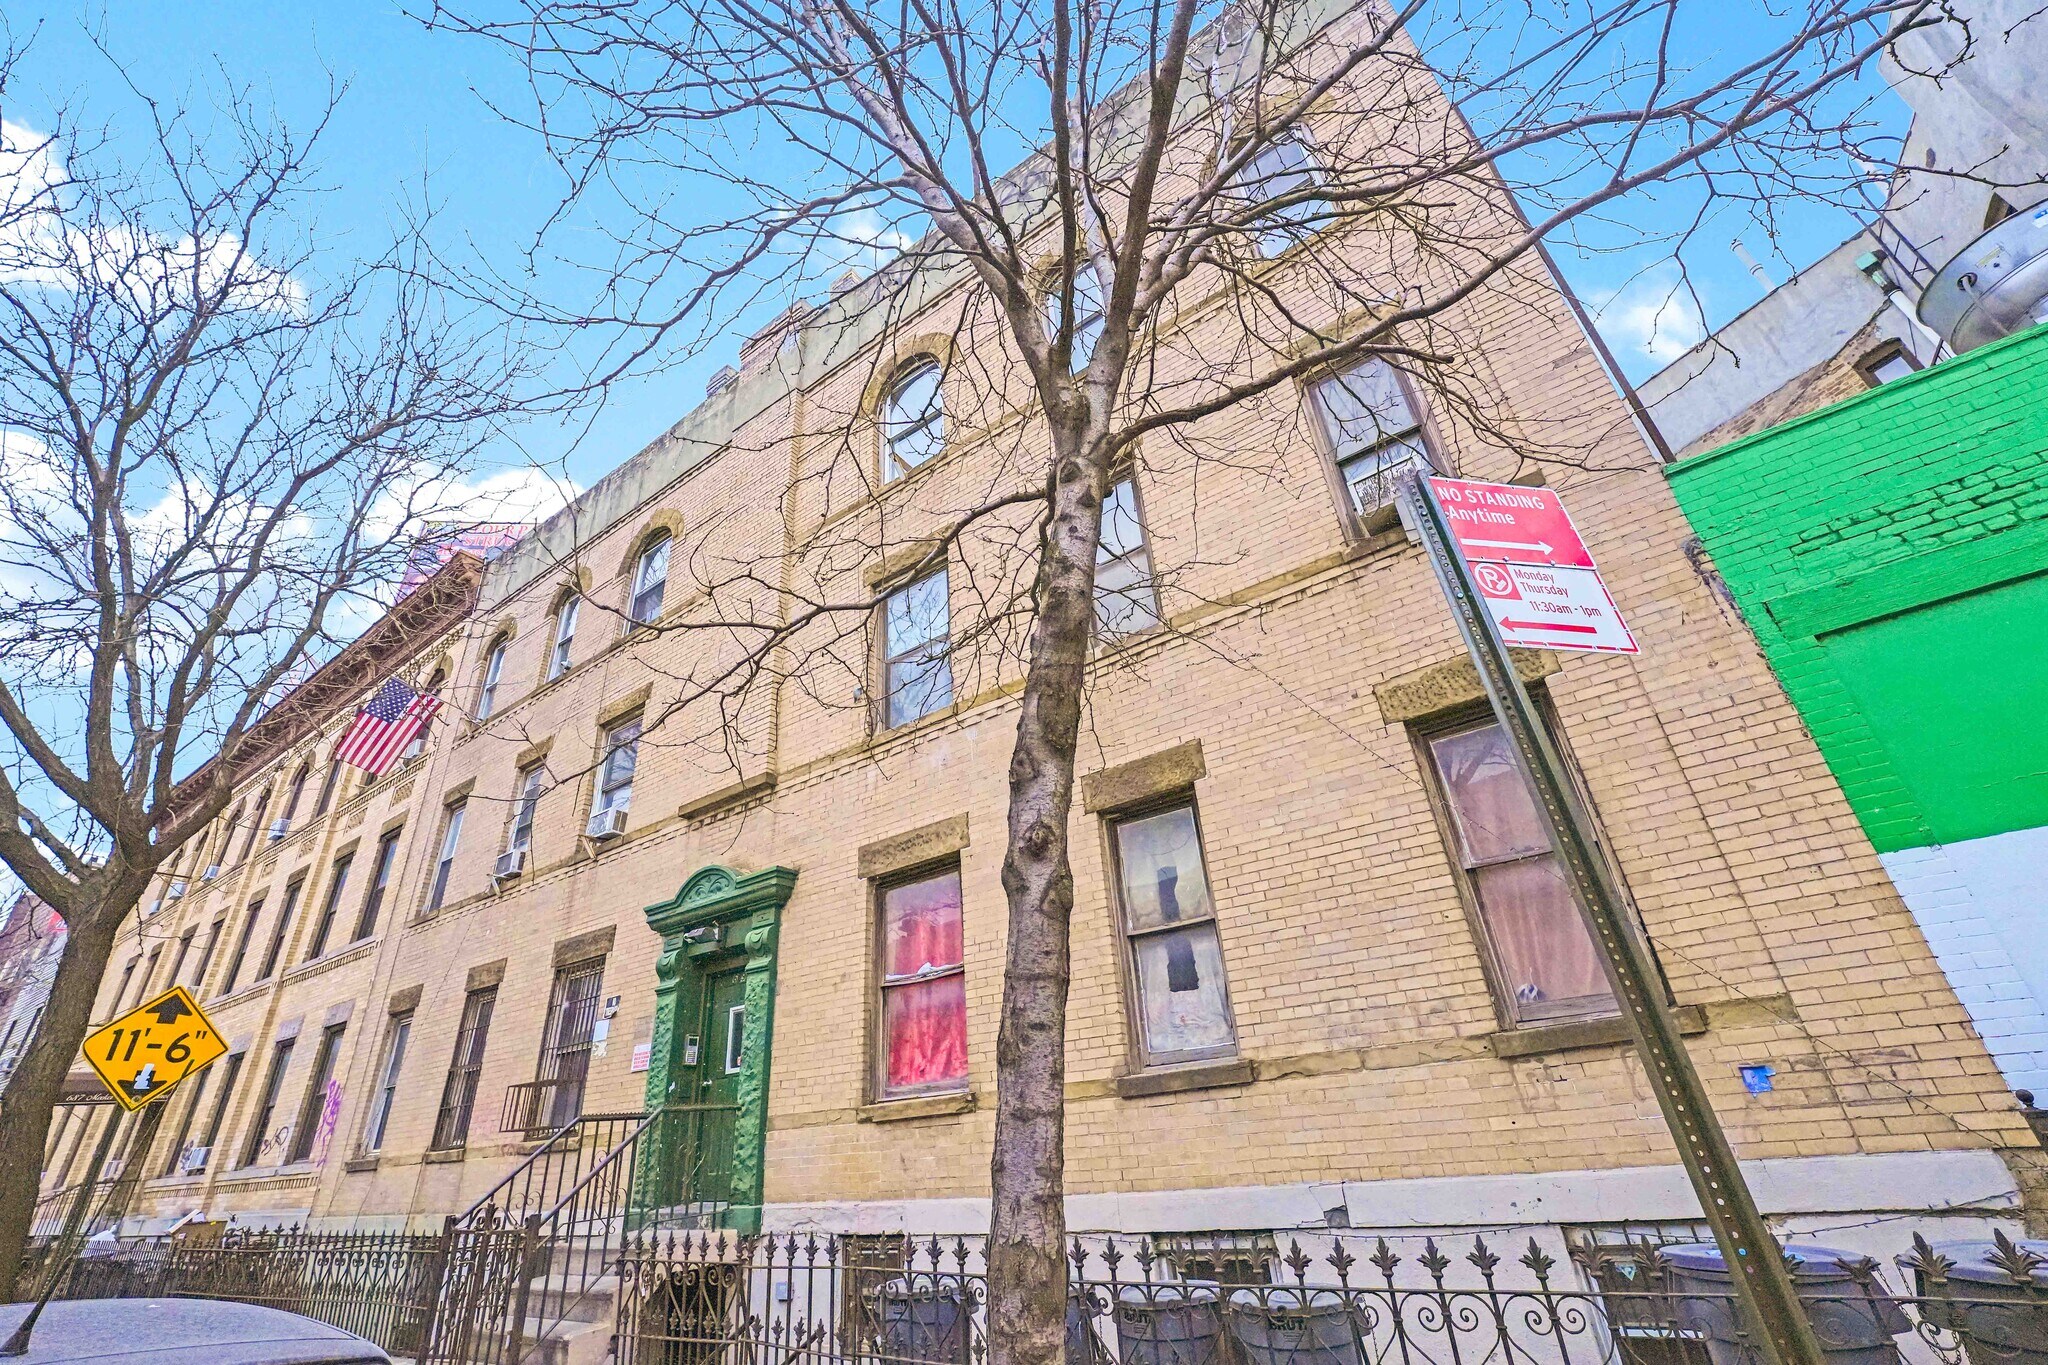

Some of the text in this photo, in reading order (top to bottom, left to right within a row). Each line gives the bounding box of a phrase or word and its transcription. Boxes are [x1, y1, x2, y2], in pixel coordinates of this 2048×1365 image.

[1436, 486, 1545, 510] NO STANDING
[1448, 506, 1516, 525] Anytime
[1513, 569, 1555, 584] Monday
[1520, 582, 1569, 598] Thursday
[1529, 600, 1573, 615] 11:30am
[1580, 605, 1602, 618] 1pm
[105, 1027, 208, 1063] 11'-6"
